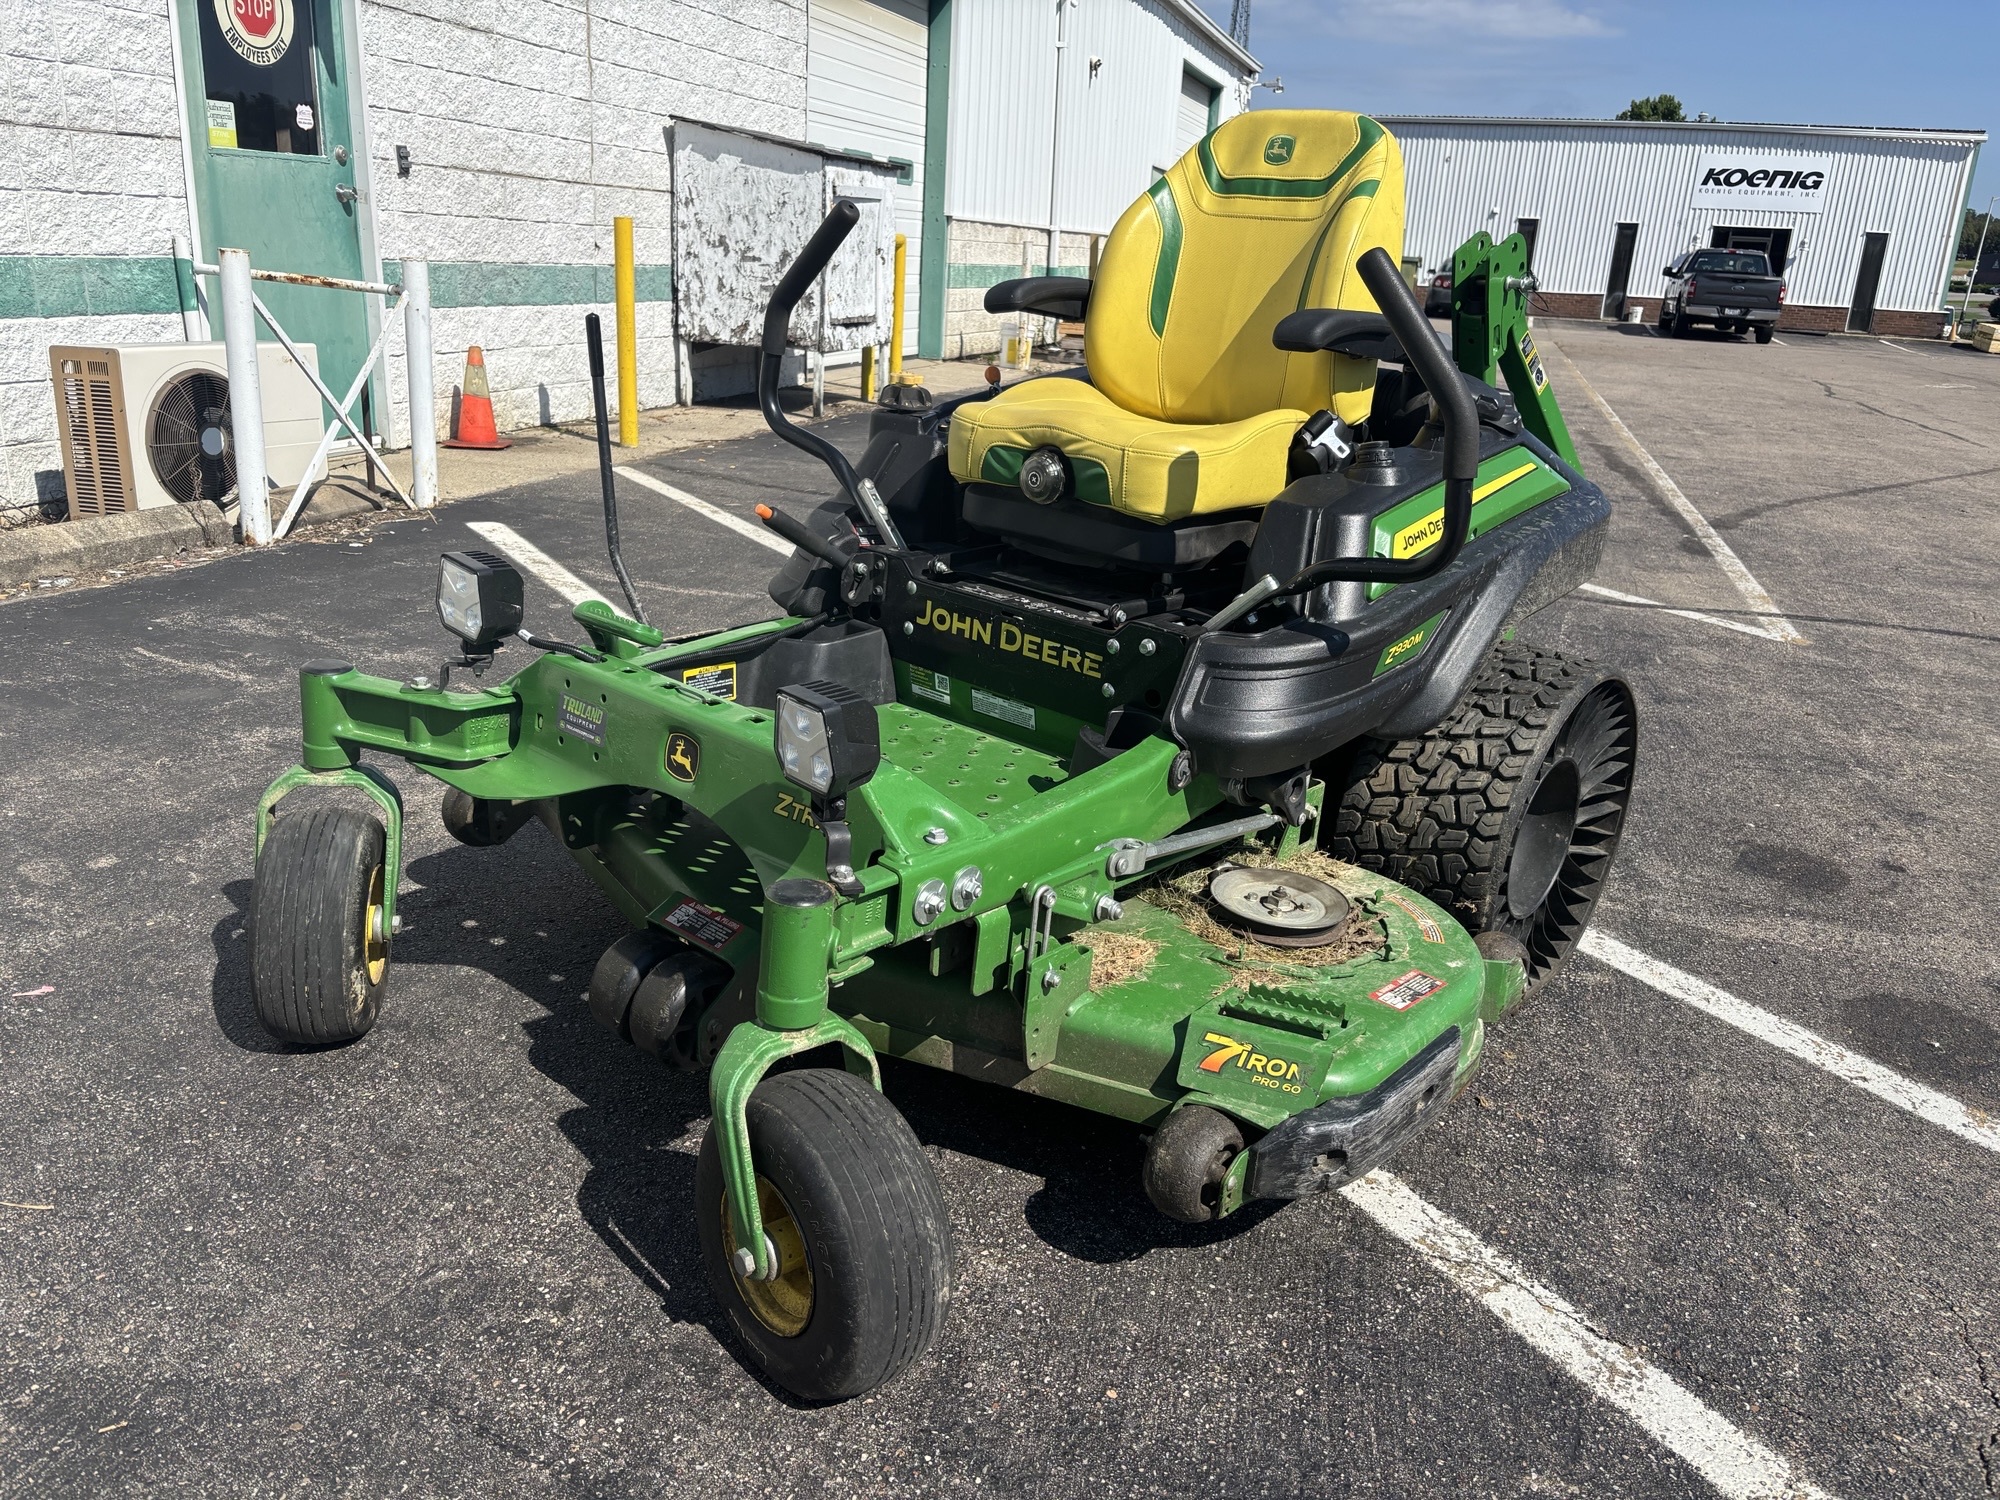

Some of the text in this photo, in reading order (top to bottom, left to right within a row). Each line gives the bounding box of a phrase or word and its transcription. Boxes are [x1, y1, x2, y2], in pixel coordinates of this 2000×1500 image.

[236, 0, 273, 19] STOP
[225, 26, 288, 63] EMPLOYEES ONLY
[1698, 187, 1733, 195] KOENIG
[1738, 189, 1794, 198] EQUIPMENT,
[1403, 516, 1445, 551] JOHN DEE
[916, 599, 1104, 680] JOHN DEERE
[1384, 630, 1425, 666] Z930M
[563, 695, 604, 725] TRULAND
[566, 713, 596, 730] EQUIPMENT
[1251, 1074, 1302, 1095] PRO 60
